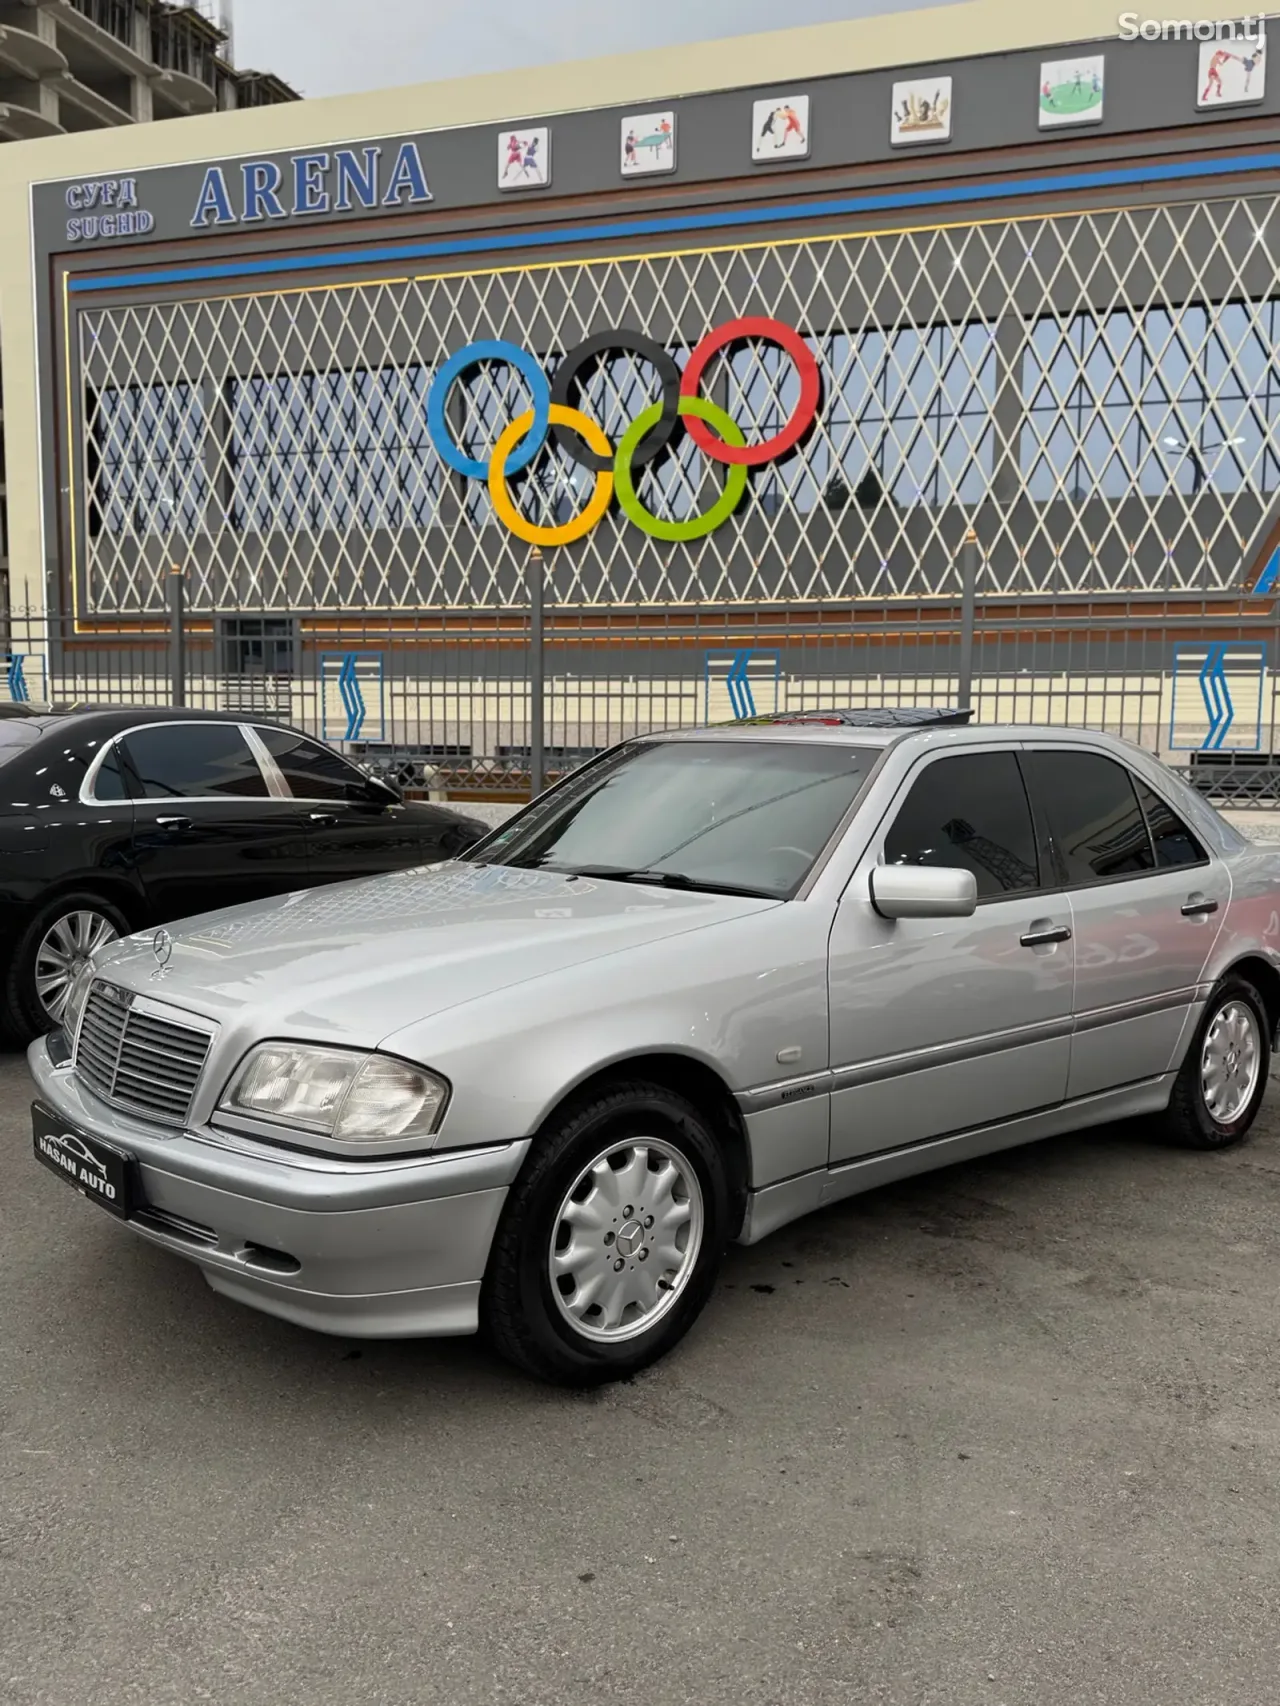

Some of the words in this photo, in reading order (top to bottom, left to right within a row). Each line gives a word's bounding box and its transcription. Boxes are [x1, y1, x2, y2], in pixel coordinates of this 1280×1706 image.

[190, 142, 433, 227] ARENA
[66, 210, 154, 240] SUGHD
[39, 1137, 77, 1175] HASAN
[79, 1168, 116, 1200] AUTO
